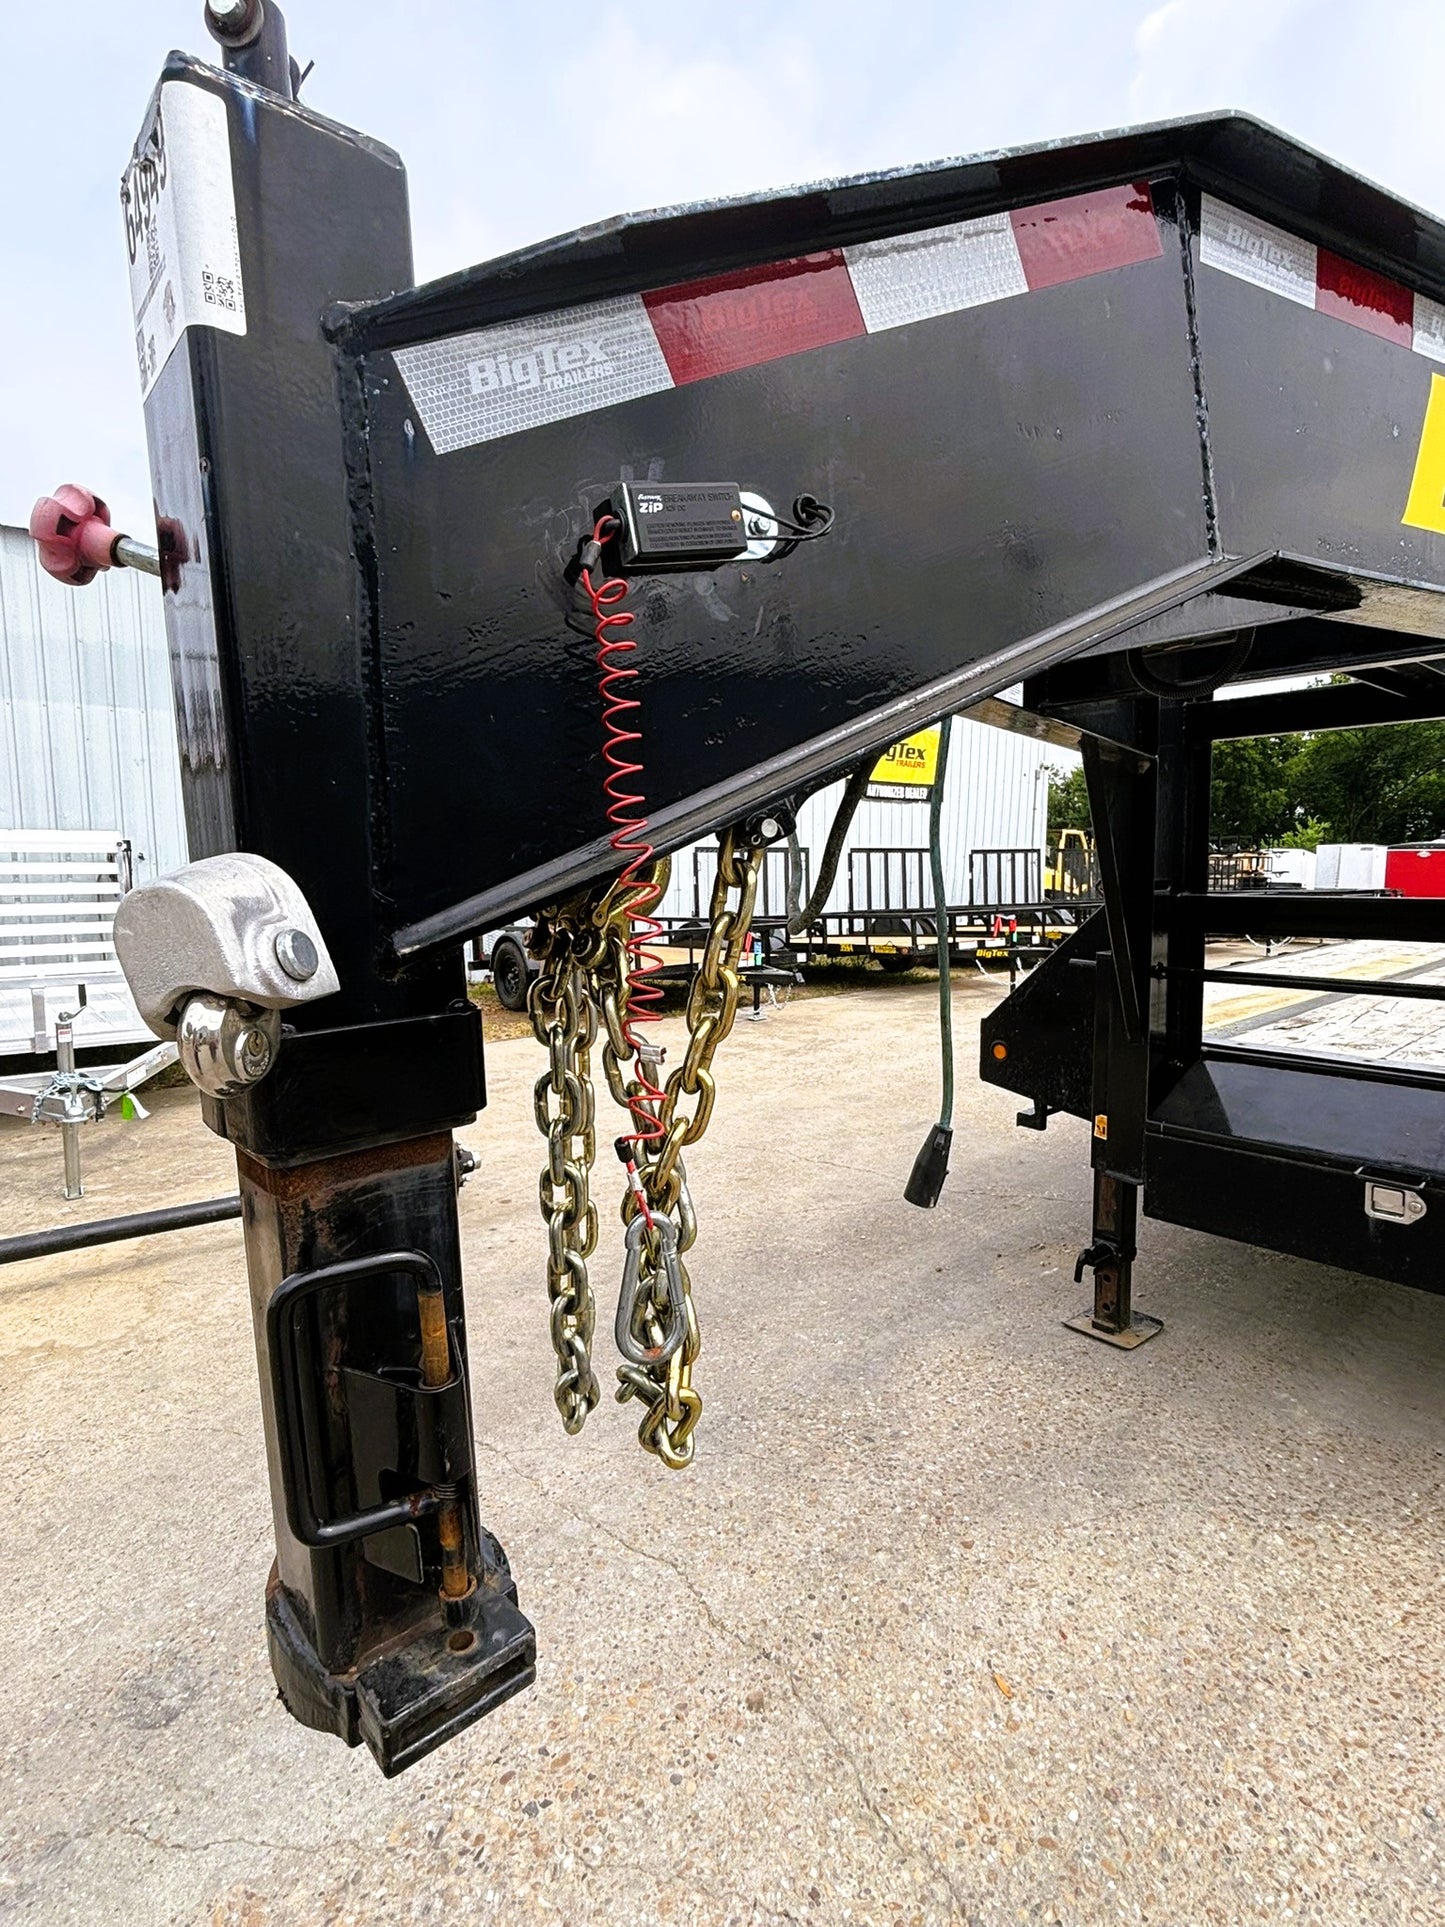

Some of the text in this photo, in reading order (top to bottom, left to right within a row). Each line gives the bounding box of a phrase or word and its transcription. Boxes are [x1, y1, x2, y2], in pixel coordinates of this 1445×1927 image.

[701, 289, 817, 334] BigTex
[466, 337, 610, 394] BigTex
[542, 361, 616, 391] TRAILERS
[885, 743, 927, 761] gTex
[896, 760, 926, 768] TRAILERS
[976, 949, 1009, 958] BigTex
